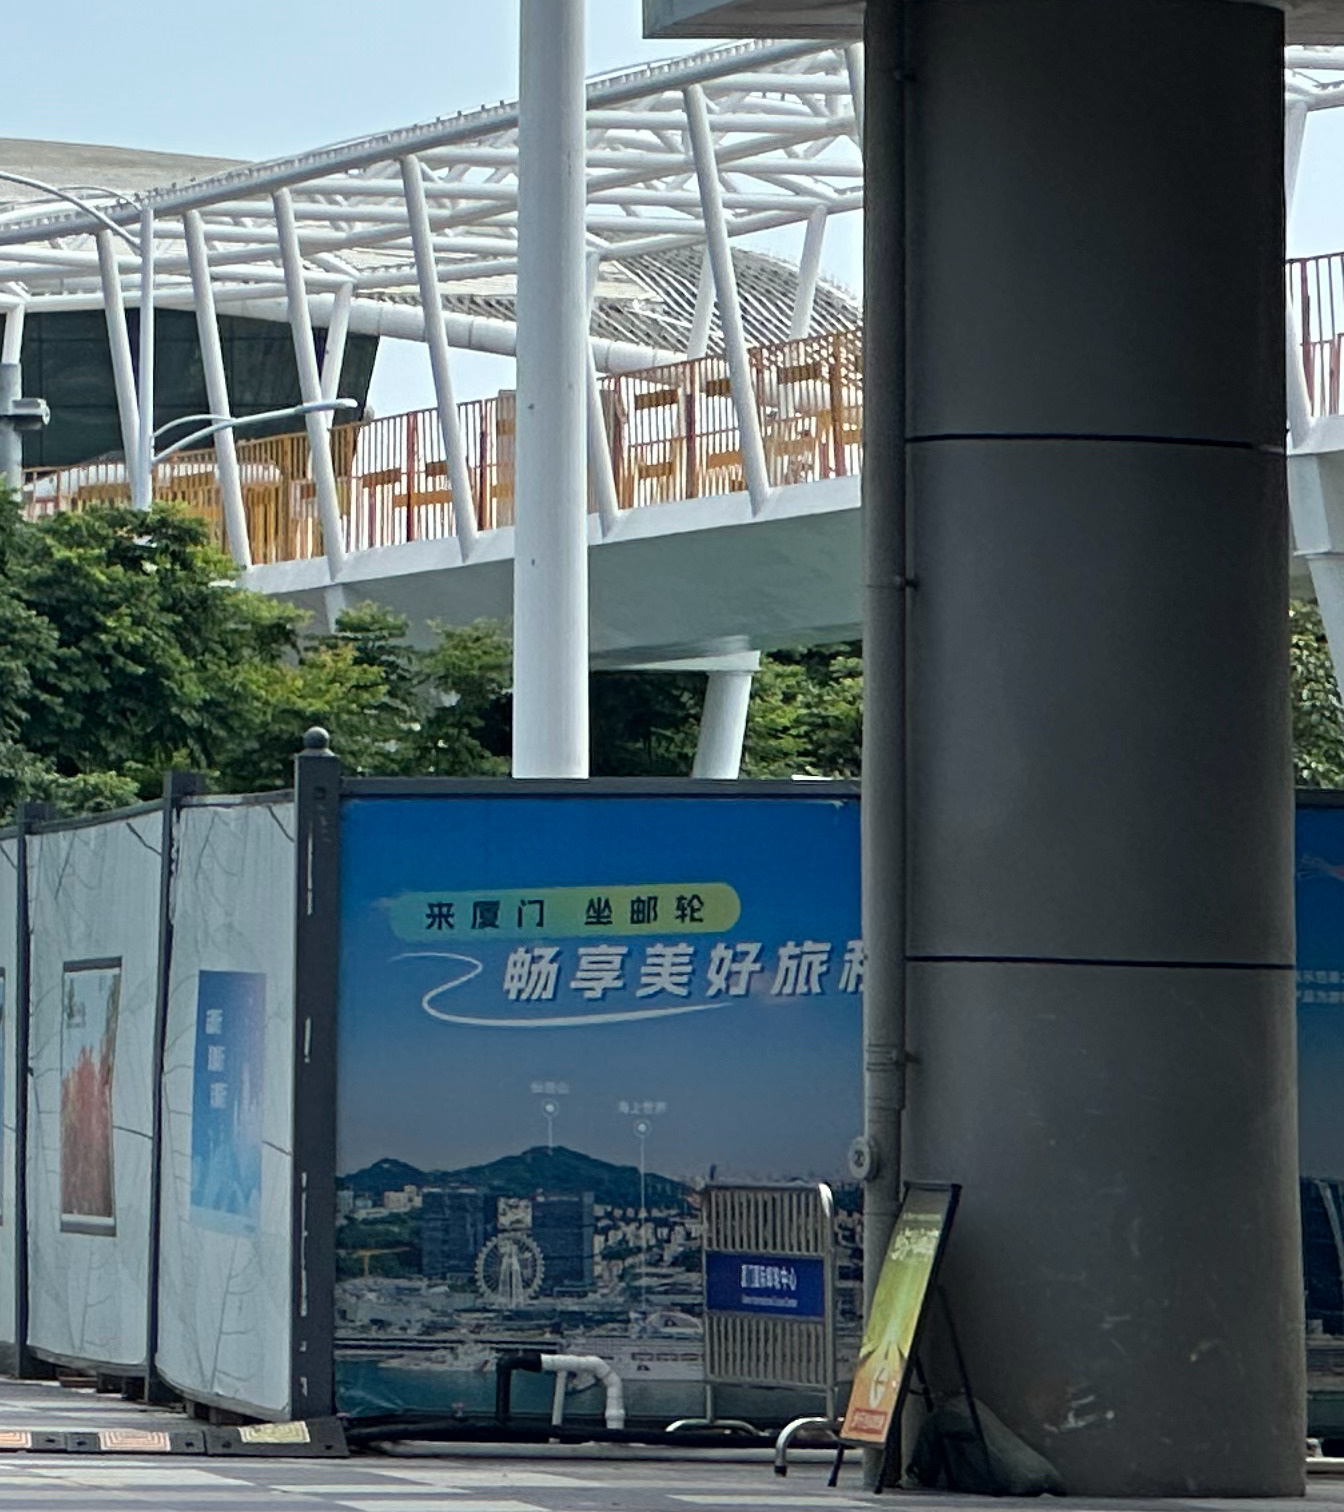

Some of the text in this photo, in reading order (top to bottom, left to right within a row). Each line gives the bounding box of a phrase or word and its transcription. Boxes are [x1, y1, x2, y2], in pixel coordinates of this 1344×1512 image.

[425, 894, 705, 930] 来厦门 坐邮轮
